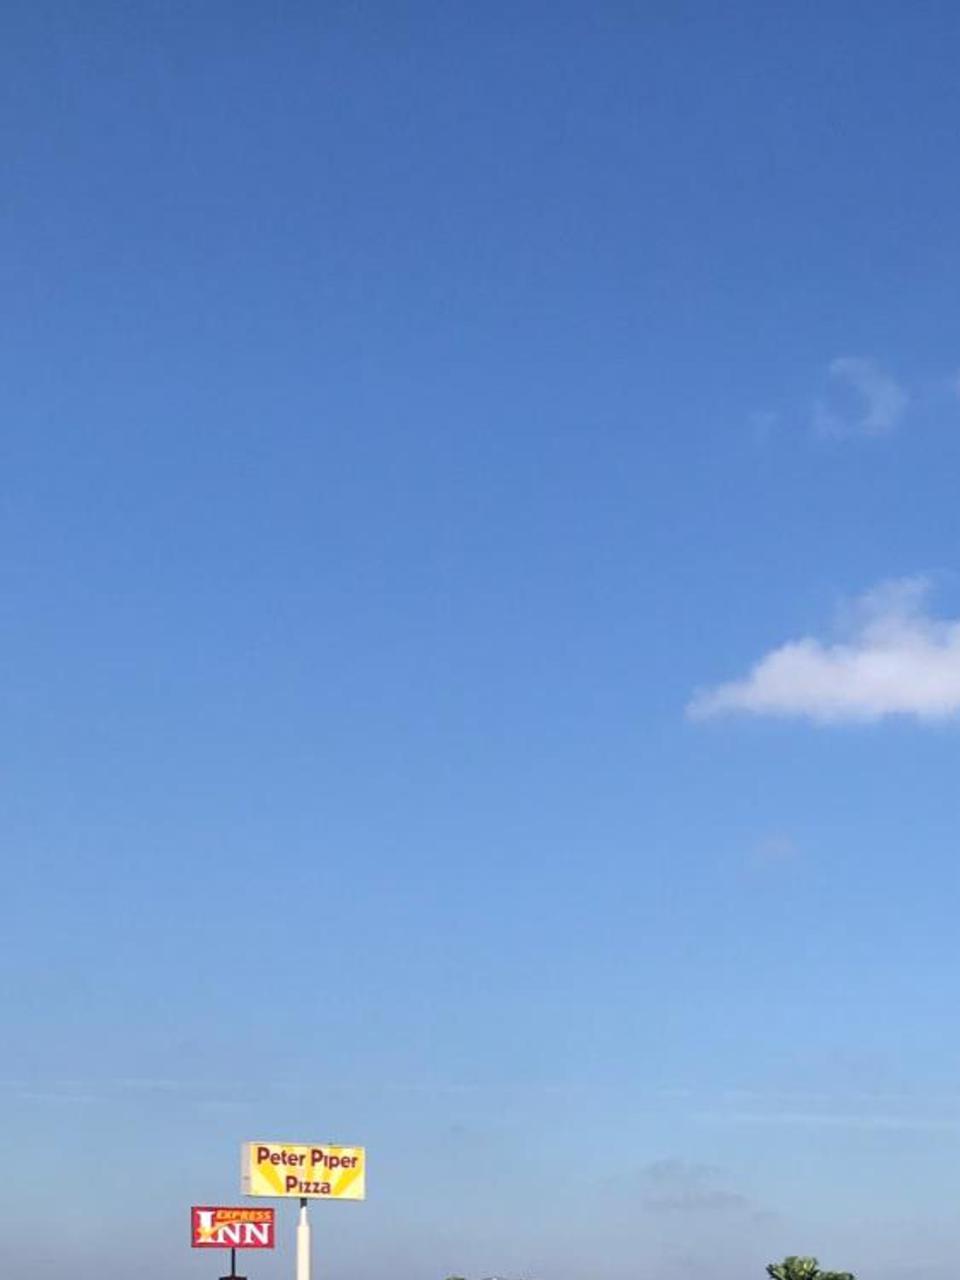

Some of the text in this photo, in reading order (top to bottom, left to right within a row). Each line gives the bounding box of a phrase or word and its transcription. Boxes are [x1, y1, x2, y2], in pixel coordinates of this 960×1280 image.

[257, 1147, 358, 1169] Peter Piper
[285, 1176, 331, 1194] Pizza
[215, 1210, 273, 1223] EXPRESS
[196, 1211, 271, 1245] INN
